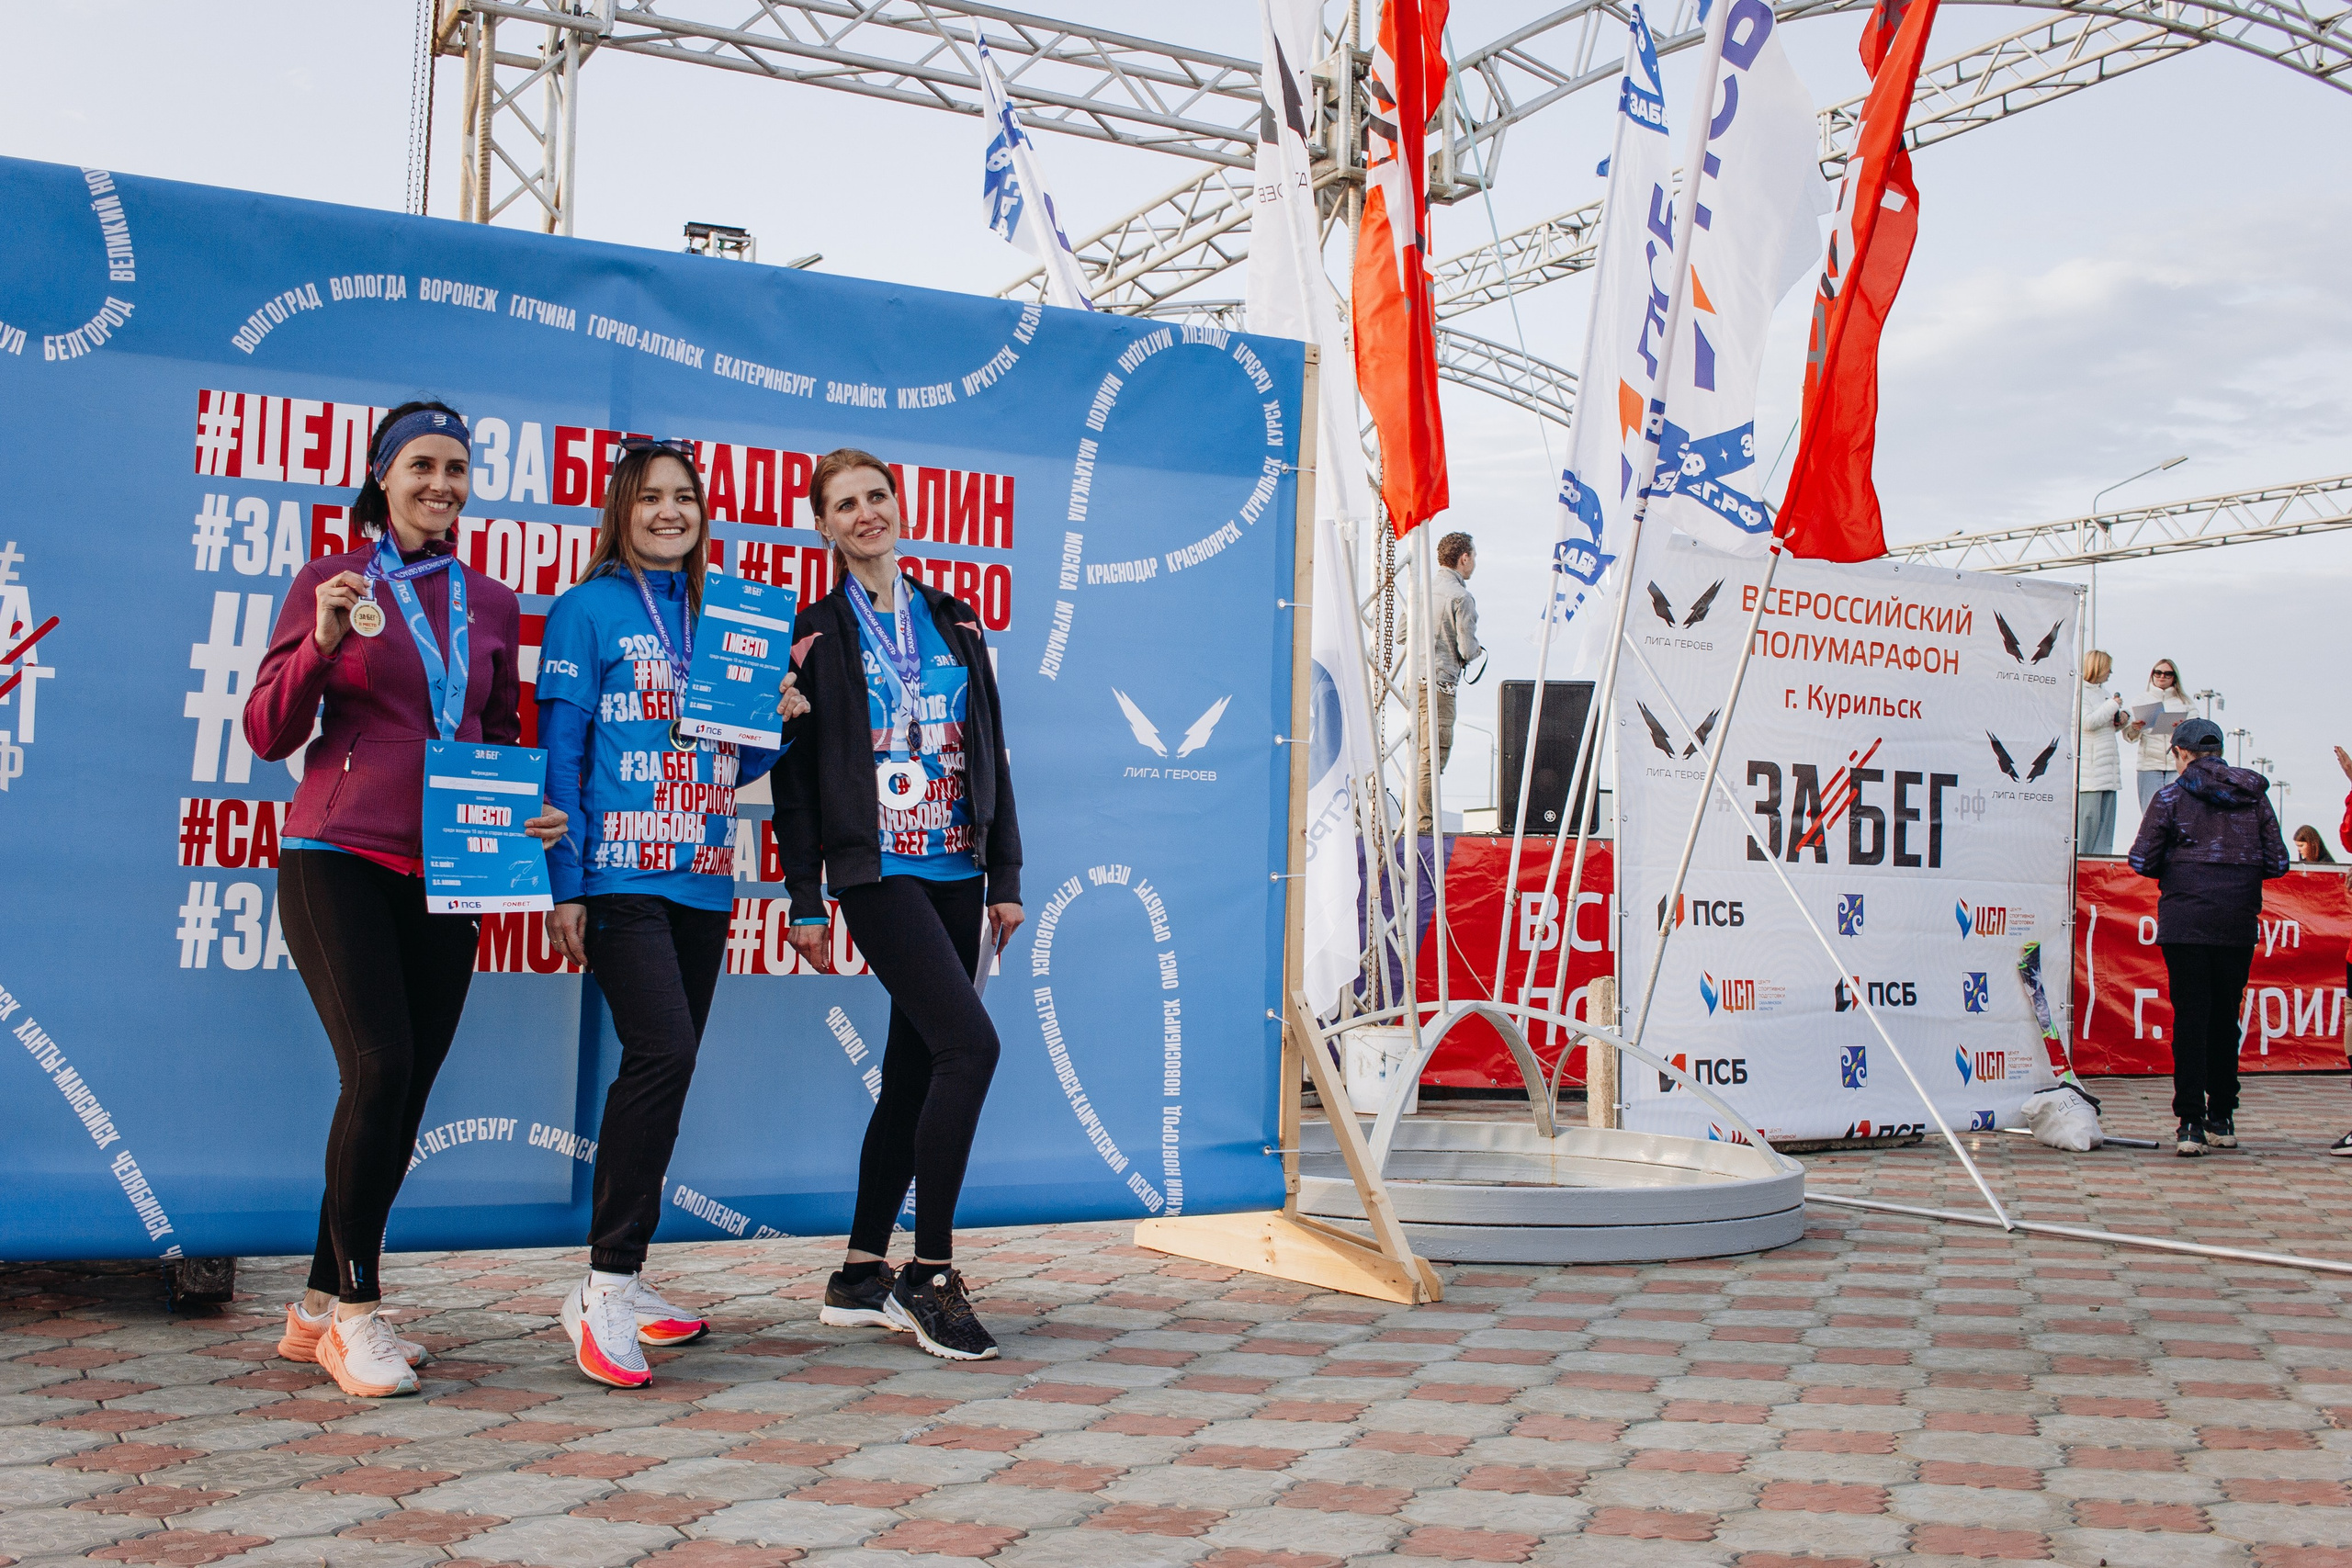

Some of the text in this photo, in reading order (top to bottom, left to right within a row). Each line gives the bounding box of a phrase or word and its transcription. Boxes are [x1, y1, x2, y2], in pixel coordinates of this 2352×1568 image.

[0, 166, 136, 361] УЛ БЕЛГОРОД ВЕЛИКИЙ НО
[231, 283, 322, 355] ВОЛГОГРАД
[330, 275, 407, 301] ВОЛОГДА
[419, 277, 499, 313] ВОРОНЕЖ
[509, 294, 577, 332] ГАТЧИНА
[587, 313, 706, 369] ГОРНО-АЛТАЙСК
[714, 353, 817, 399] ЕКАТЕРИНБУРГ
[826, 380, 888, 409] ЗАРАЙСК
[898, 381, 956, 410] ИЖЕВСК
[962, 344, 1021, 397] ИРКУТСК
[196, 389, 384, 489] #ЦЕЛ
[1038, 325, 1284, 681] КРАСНОДАР КРАСНОЯРСК КУРИЛЬСК КУРСК КЫЗЫЛ ЛИПЕЦК МАГАДАН МАЙКОП МАХАЧКАЛА МОСКВА МУРМАНСК
[395, 582, 413, 604] ПСБ
[453, 581, 462, 600] ПСБ
[849, 584, 898, 656] САХАЛИНСКАЯ ОБЛАСТЬ
[1742, 584, 1973, 637] ВСЕРОССИЙСКИЙ
[618, 634, 667, 660] 202
[653, 615, 671, 648] ОБЛАСТЬ
[729, 633, 770, 659] МЕСТО
[1644, 636, 1714, 651] ЛИГА ГЕРОЕВ
[545, 660, 579, 678] ПСБ
[1751, 629, 1960, 675] ПОЛУМАРАФОН
[726, 664, 739, 681] 10
[738, 666, 754, 683] КМ
[1996, 671, 2057, 685] ЛИГА ГЕРОЕВ
[1784, 683, 1924, 720] г. Курильск
[706, 727, 763, 741] ПСБ FONBET
[619, 751, 699, 782] #ЗАБЕГ
[1123, 767, 1217, 781] ЛИГА ГЕРОЕВ
[1645, 767, 1706, 781] ЛИГА ГЕРОЕ
[1991, 790, 2054, 803] ЛИГА ГЕРОЕВ
[468, 805, 513, 828] МЕСТО
[603, 812, 707, 843] #ЛЮБОВЬ
[467, 837, 499, 853] 10 КМ
[594, 842, 676, 871] #ЗАБЕГ
[1088, 863, 1131, 886] ПЕРМЬ
[1030, 875, 1084, 977] ПЕТРОЗАВОДСК
[1133, 878, 1172, 942] ОРЕНБУРГ
[1692, 899, 2007, 938] ПСБ ЦСП
[1158, 950, 1180, 990] ОМСК
[1723, 979, 1917, 1013] ЦСП ПСБ
[825, 1006, 870, 1066] ТЮМЕНЬ
[1163, 998, 1182, 1097] НОВОСИБИРСК
[1034, 986, 1130, 1175] ПЕТРОПАВЛОВСК-КАМЧАТСКИЙ
[1695, 1051, 2006, 1086] ПСБ ЦСП
[12, 1017, 121, 1150] ХАНТЫ-МАНСИЙСК
[110, 1150, 174, 1241] ЧЕЛЯБИНСК
[410, 1117, 598, 1173] КТ-ПЕТЕРБУРГ САРАНСК
[1161, 1105, 1182, 1177] НОВГОРОД
[1126, 1171, 1165, 1213] ПСКОВ
[673, 1184, 752, 1236] СМОЛЕНСК
